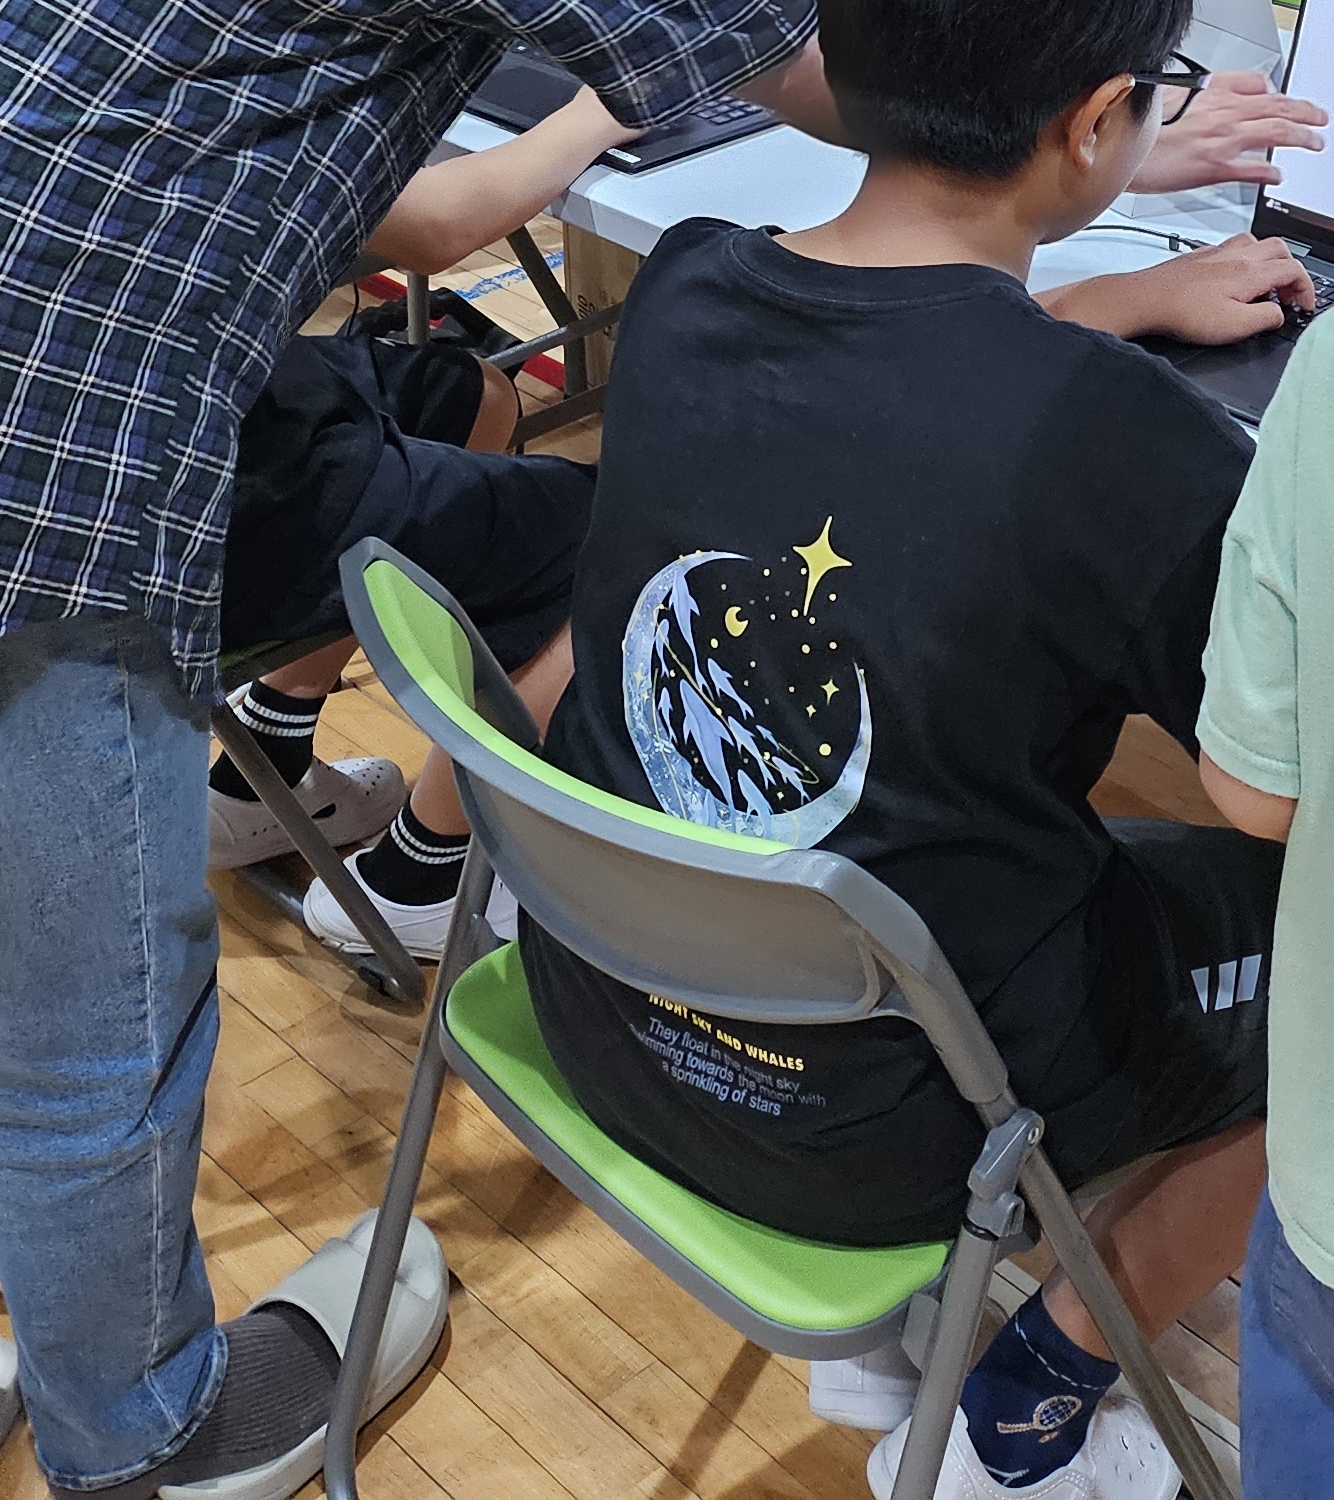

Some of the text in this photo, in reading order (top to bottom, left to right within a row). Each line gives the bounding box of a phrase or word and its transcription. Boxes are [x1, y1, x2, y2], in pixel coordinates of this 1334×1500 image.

[648, 993, 805, 1071] NIGHT SKY AND WHALES
[649, 1017, 680, 1046] They
[682, 1032, 709, 1055] float
[711, 1044, 722, 1060] in
[776, 1077, 800, 1094] sky
[662, 1061, 781, 1116] a sprinkling of stars
[686, 1051, 734, 1082] towards
[738, 1073, 756, 1091] the
[759, 1085, 794, 1104] moon
[798, 1092, 826, 1107] with
